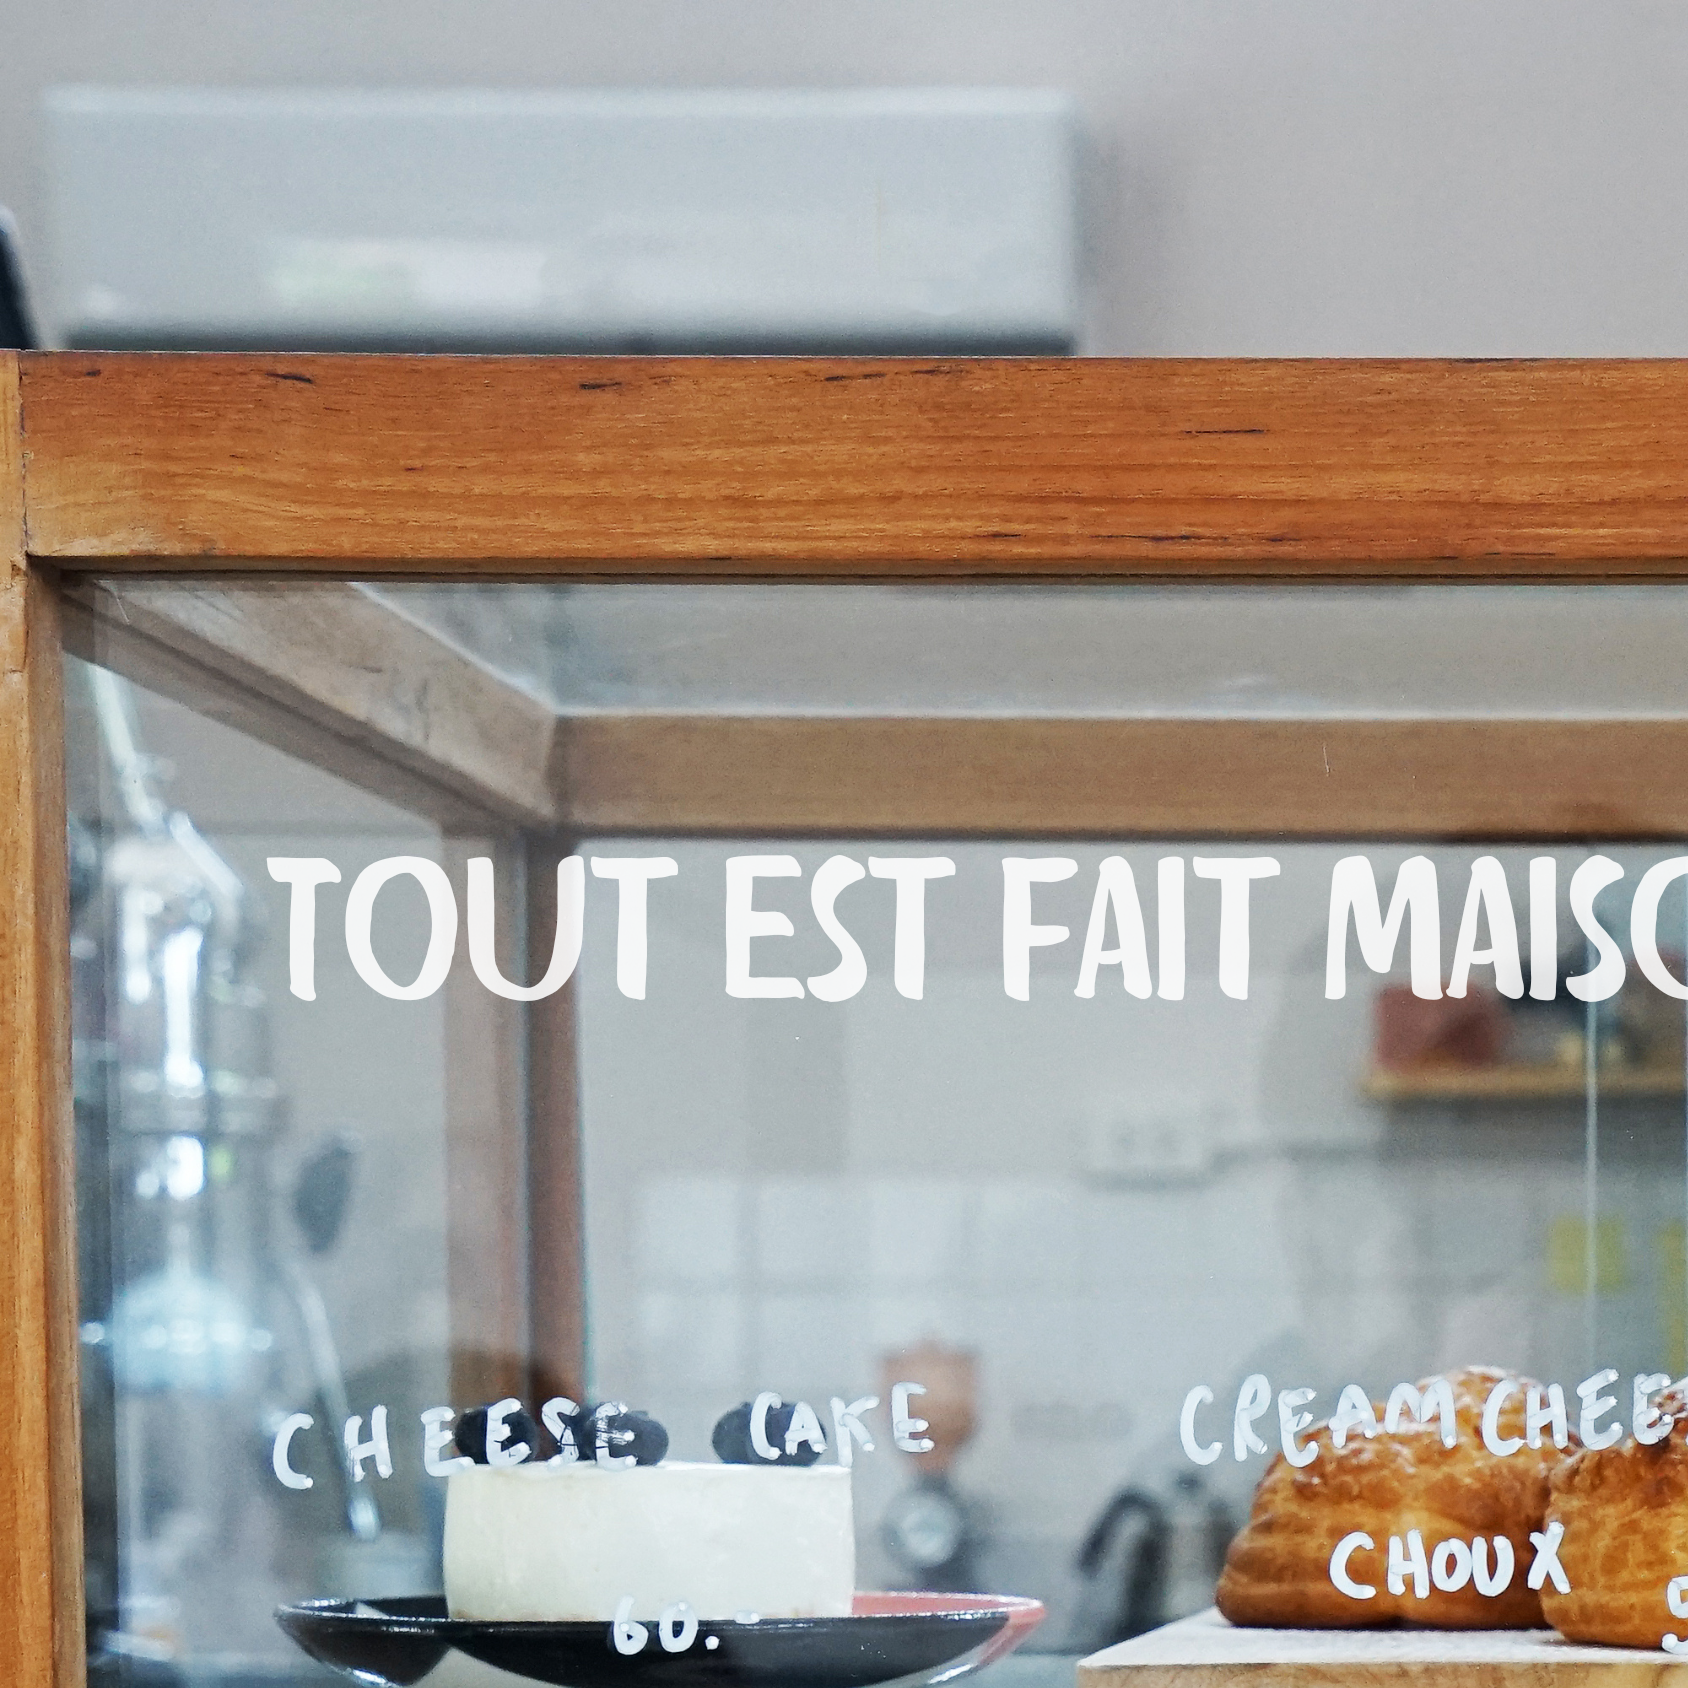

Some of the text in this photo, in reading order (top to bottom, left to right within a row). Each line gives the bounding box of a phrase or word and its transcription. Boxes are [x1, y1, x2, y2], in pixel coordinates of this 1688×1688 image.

[266, 854, 679, 1002] TOUT
[724, 854, 957, 1002] EST
[1001, 855, 1281, 1001] FAIT
[272, 1381, 935, 1491] CHEESE CAKE
[1329, 1520, 1572, 1601] CHOUX
